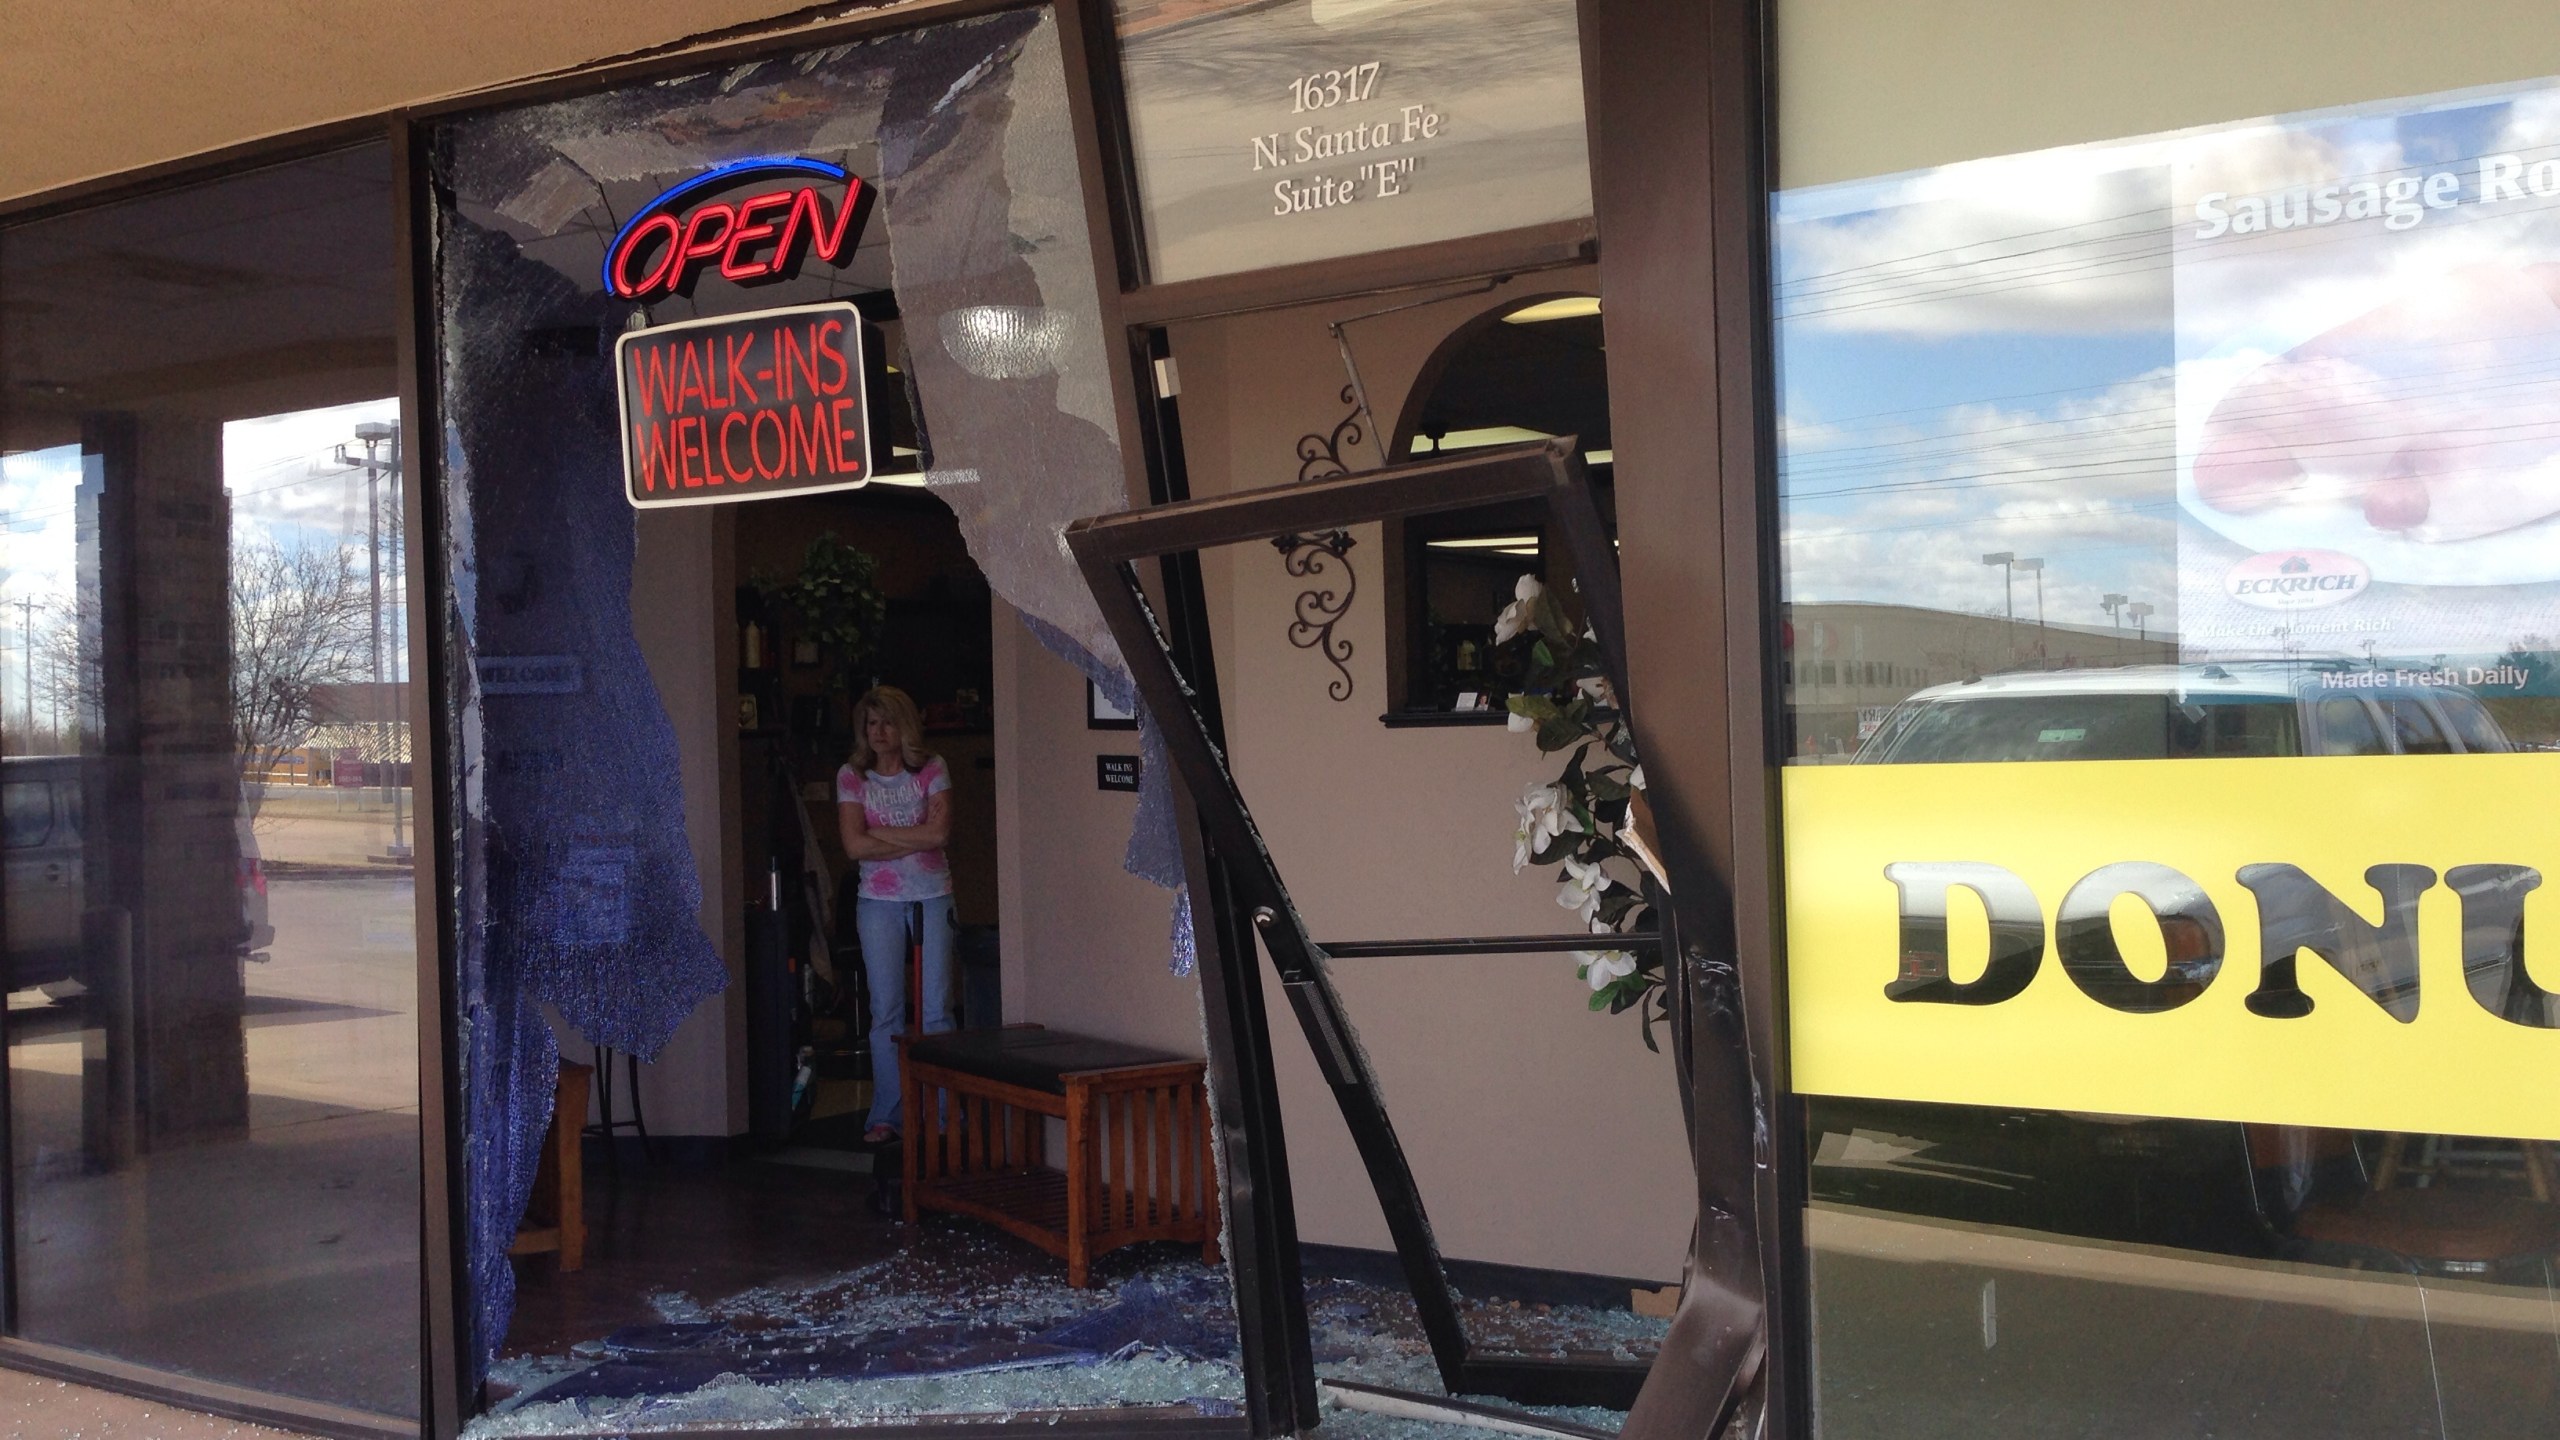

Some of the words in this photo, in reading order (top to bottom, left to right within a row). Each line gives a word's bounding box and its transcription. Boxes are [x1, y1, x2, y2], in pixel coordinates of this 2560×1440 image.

[1288, 61, 1380, 114] 16317
[1251, 133, 1287, 171] N.
[1295, 121, 1391, 163] Santa
[1400, 104, 1439, 143] Fe
[1274, 175, 1355, 216] Suite
[1360, 157, 1415, 198] "E"
[2195, 170, 2460, 240] Sausage
[614, 177, 861, 296] OPEN
[633, 320, 849, 417] WALK-INS
[636, 399, 859, 492] WELCOME
[2235, 574, 2358, 596] ECKRICH
[2200, 624, 2244, 638] Make
[2250, 622, 2276, 636] the
[2354, 616, 2396, 631] Rich.
[2322, 669, 2388, 689] Made
[2395, 667, 2460, 687] Fresh
[2467, 664, 2529, 690] Daily
[865, 780, 924, 810] AMERICAN
[1105, 763, 1122, 772] WALK
[1105, 774, 1134, 784] WELCOME
[1884, 860, 2560, 1030] DONU
